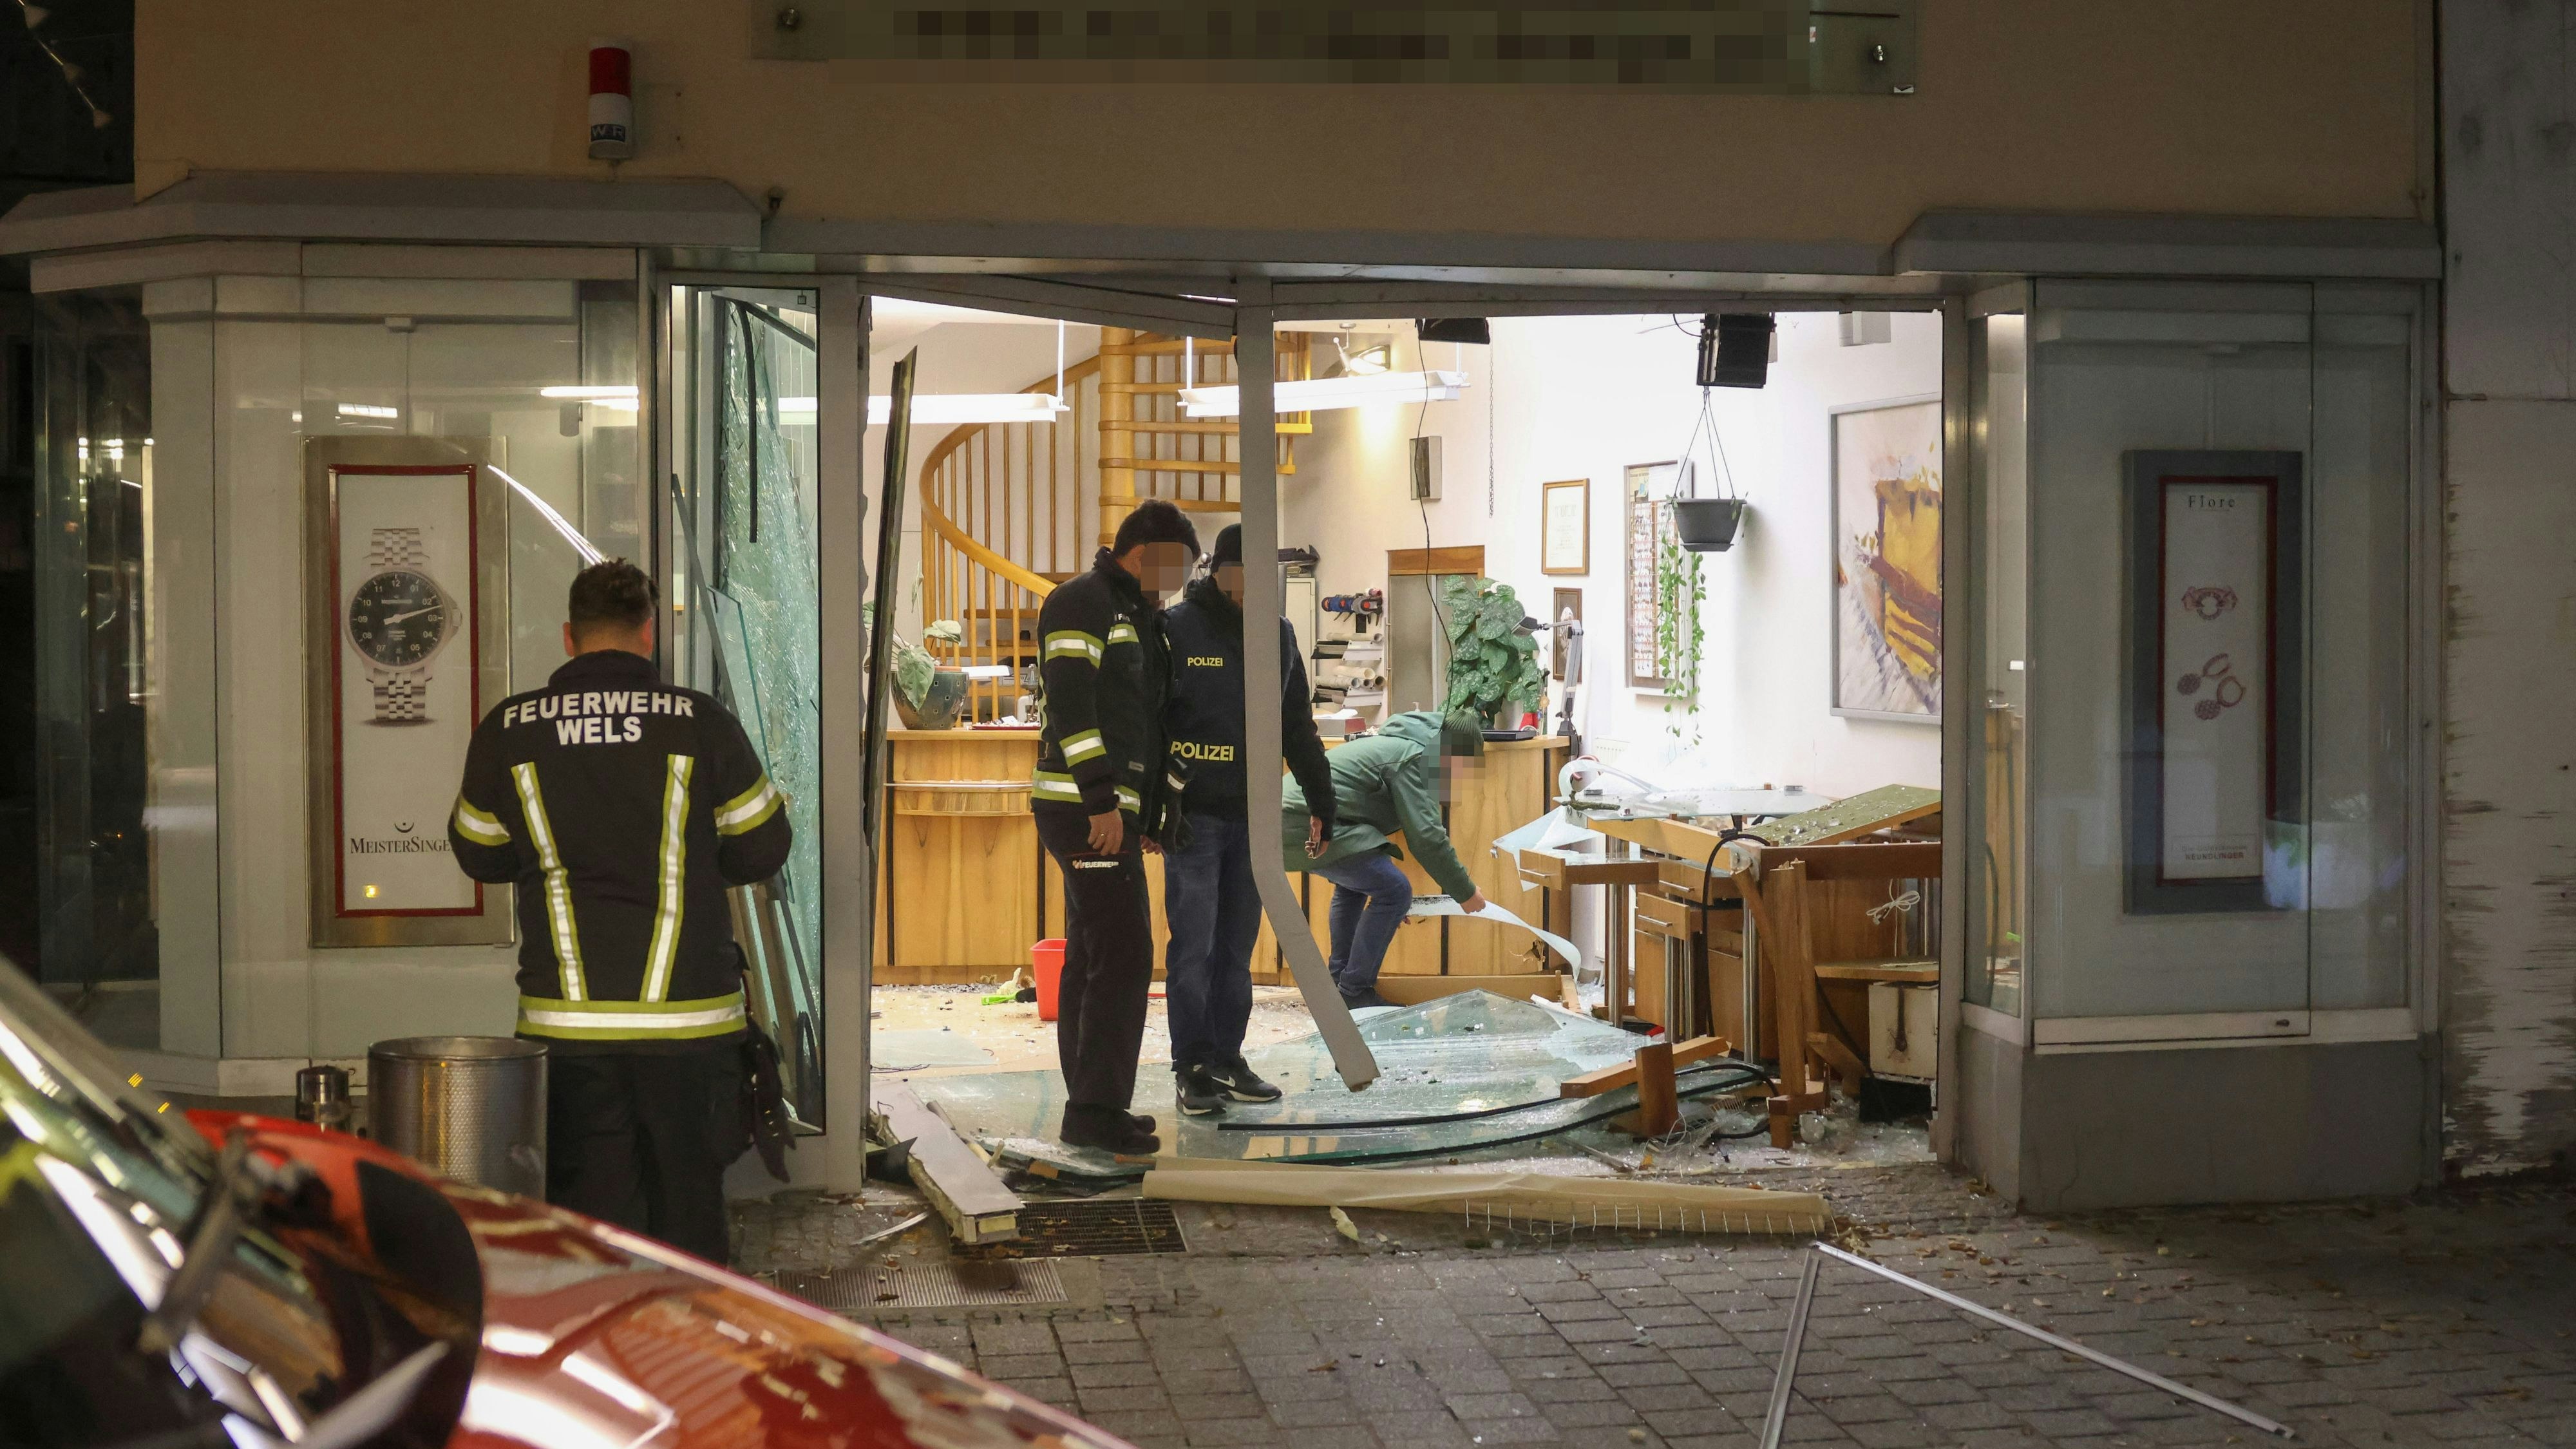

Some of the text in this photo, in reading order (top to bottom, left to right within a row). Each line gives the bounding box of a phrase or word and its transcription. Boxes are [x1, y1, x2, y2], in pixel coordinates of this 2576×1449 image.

[1188, 657, 1224, 667] POLIZEI
[504, 691, 694, 729] FEUERWEHR
[555, 716, 643, 746] WELS
[1170, 741, 1234, 762] POLIZEI
[350, 836, 453, 854] MEISTERSINGE
